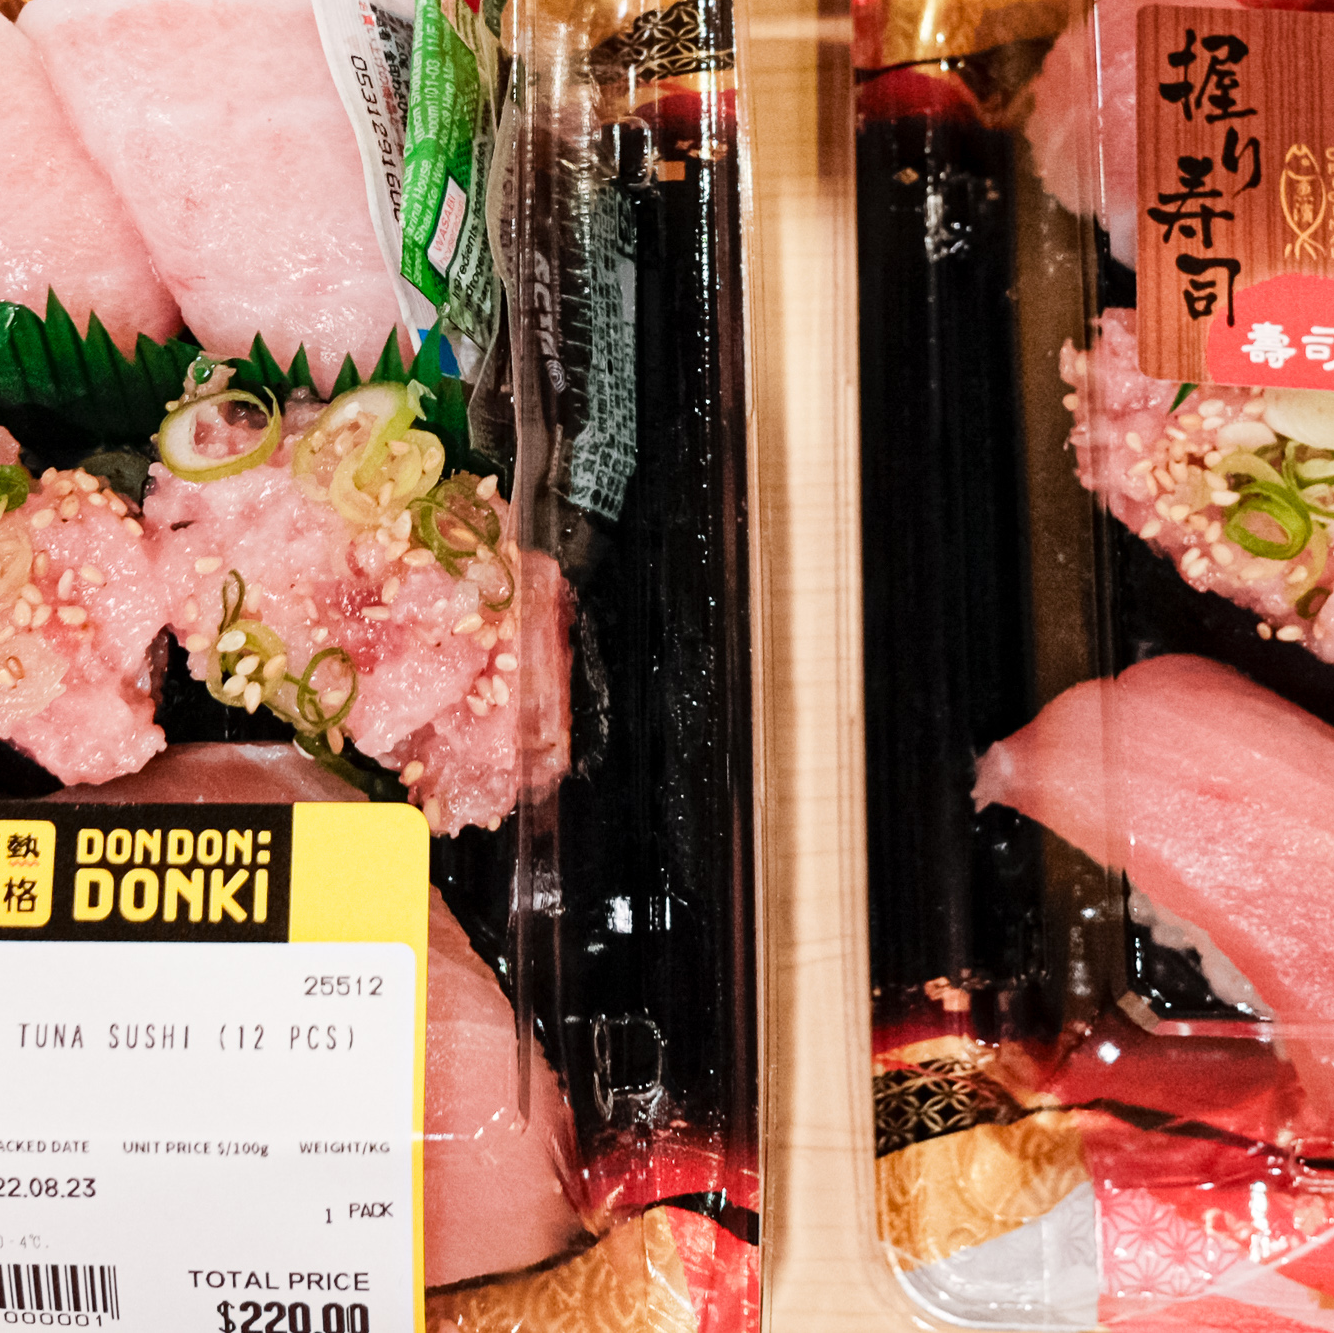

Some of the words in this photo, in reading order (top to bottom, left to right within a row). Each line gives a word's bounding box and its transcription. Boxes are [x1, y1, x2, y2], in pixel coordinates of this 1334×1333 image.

[1147, 28, 1262, 328] 握り寿司
[433, 194, 457, 253] WASABI
[72, 868, 269, 923] DONKI
[304, 976, 383, 996] 25512
[20, 1023, 84, 1049] TUNA
[108, 1023, 189, 1050] SUSHI
[219, 1024, 264, 1051] (12
[290, 1024, 354, 1051] PCS)
[51, 1140, 88, 1154] DATE
[122, 1141, 160, 1154] UNIT
[165, 1141, 209, 1155] PRICE
[217, 1142, 269, 1158] $/100g
[299, 1142, 391, 1156] WEIGHT/KG
[325, 1208, 333, 1225] 1
[349, 1202, 393, 1219] PACK
[188, 1270, 280, 1290] TOTAL
[288, 1272, 370, 1292] PRICE
[3, 1309, 105, 1328] 000001
[216, 1300, 370, 1333] $22000
